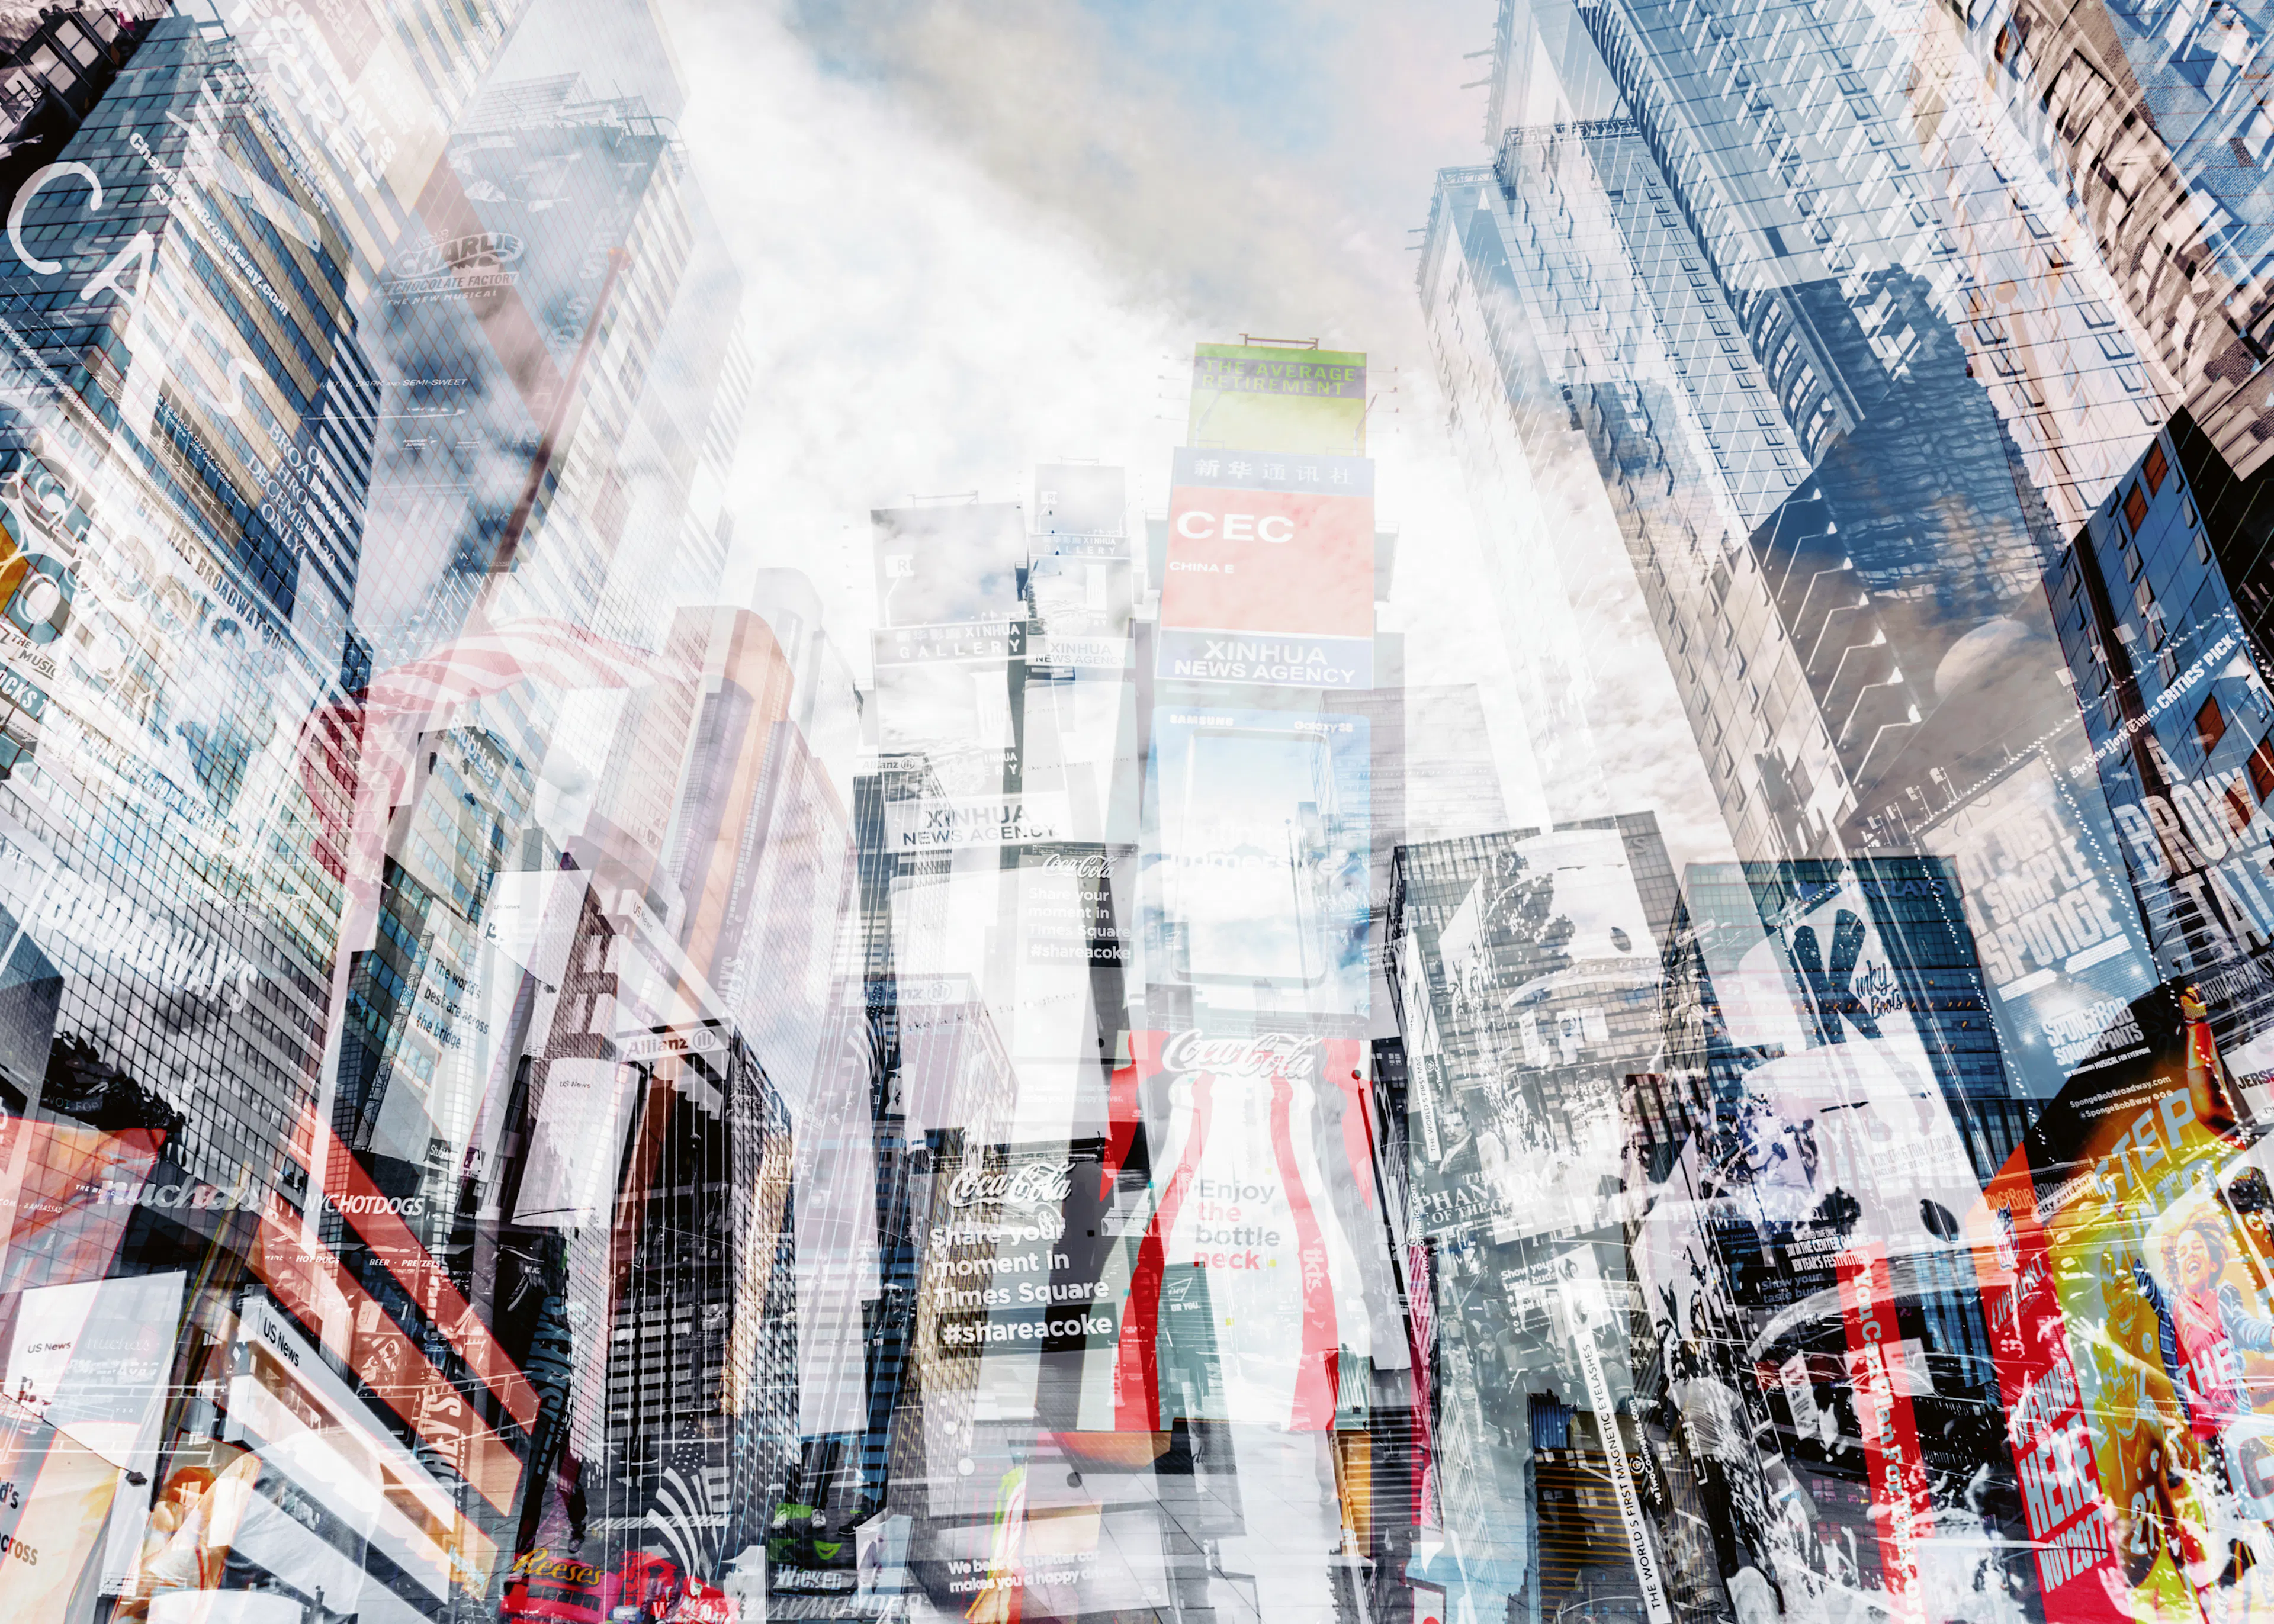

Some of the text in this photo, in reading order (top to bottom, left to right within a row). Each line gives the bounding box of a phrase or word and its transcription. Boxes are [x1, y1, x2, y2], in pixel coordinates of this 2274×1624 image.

[227, 0, 378, 198] TICKET
[265, 115, 328, 194] CORNER
[284, 121, 348, 202] AROUND
[276, 148, 331, 217] STREET
[126, 131, 293, 317] CharlieOnBroadway.com
[468, 273, 518, 287] FACTORY
[411, 290, 497, 305] NEW MUSICAL
[1205, 359, 1356, 382] THE AVERAGE
[1202, 374, 1345, 395] RETIREMENT
[268, 419, 351, 532] BROADWAY
[308, 445, 333, 481] ON
[1194, 458, 1353, 485] 新华通讯社
[267, 449, 335, 542] THROUGH
[246, 452, 336, 568] DECEMBER 30
[261, 503, 307, 562] ONLY!
[1176, 510, 1295, 544] CEC
[1043, 545, 1116, 555] GALLERY
[1083, 536, 1116, 545] XINHUA
[1169, 561, 1234, 574] CHINA E
[191, 556, 266, 633] BROADWAY
[9, 632, 32, 651] THE
[965, 623, 1020, 639] XINHUA
[899, 639, 1021, 660] GALLERY
[1035, 654, 1127, 665] NEWS AGENCY
[1049, 642, 1112, 654] XINHUA
[1203, 639, 1328, 664] XINHUA
[1174, 660, 1356, 684] NEWS AGENCY
[2067, 632, 2238, 780] The New York Times CRITICS' PICK
[1170, 714, 1337, 733] SAMSUNG Galaxy
[83, 732, 140, 777] WINTER
[133, 767, 185, 809] GARDEN
[2143, 734, 2185, 785] A
[927, 803, 1030, 828] XINHUA
[903, 824, 1059, 847] NEWS AGENCY
[1042, 853, 1119, 879] Coca-Cola
[1980, 832, 2096, 925] SIMPLE
[1028, 887, 1109, 905] Share your
[1028, 905, 1109, 919] moment in
[37, 866, 262, 1016] BROADWAY'S
[1028, 922, 1132, 941] Times Square
[1976, 880, 2124, 986] SPONGE
[1030, 943, 1131, 960] #shareacoke
[435, 957, 451, 980] The
[424, 985, 447, 1009] best
[446, 1001, 461, 1018] are
[416, 1012, 462, 1051] the bridge.
[2039, 993, 2136, 1049] SPONGEBOB
[628, 1037, 689, 1056] Allianz
[1161, 1028, 1325, 1079] Coca-Cola
[2051, 1020, 2145, 1068] SQUAREPANTS
[2093, 1055, 2119, 1070] MUSICAL
[1420, 1075, 1430, 1096] FIRST
[2069, 1073, 2172, 1110] SpongeBobBroadway.com
[1424, 1096, 1435, 1134] WORLD'S
[2092, 1086, 2197, 1218] STEP
[948, 1162, 1077, 1208] Coca-Cola
[1202, 1179, 1275, 1204] Enjoy
[1197, 1202, 1242, 1222] the
[1431, 1209, 1452, 1224] OF
[1454, 1204, 1488, 1218] THE
[1196, 1224, 1281, 1247] bottle
[1800, 1236, 1842, 1255] THE CENTER
[369, 1258, 390, 1267] BEER
[932, 1249, 1070, 1277] moment in
[1195, 1247, 1261, 1271] neck
[1303, 1247, 1328, 1293] tkts
[1801, 1248, 1872, 1271] YEAR'S FESTIVITIES!
[1501, 1266, 1528, 1280] Show
[1504, 1278, 1530, 1291] taste
[1761, 1272, 1823, 1292] Show your
[934, 1279, 1110, 1307] Times Square
[1515, 1286, 1547, 1302] berry
[1762, 1285, 1824, 1304] taste buds
[1510, 1301, 1536, 1317] good
[942, 1313, 1113, 1346] #shareacoke
[27, 1340, 72, 1355] US News
[263, 1320, 301, 1368] US News
[1583, 1342, 1660, 1612] THE WORLD'S FIRST MAGNETIC EYELASHES
[2019, 1412, 2096, 1540] HERE
[513, 1547, 605, 1586] Reese's
[948, 1560, 970, 1575] We
[1035, 1552, 1075, 1567] better
[949, 1575, 996, 1593] makes
[996, 1574, 1023, 1591] you
[1036, 1568, 1079, 1587] happy
